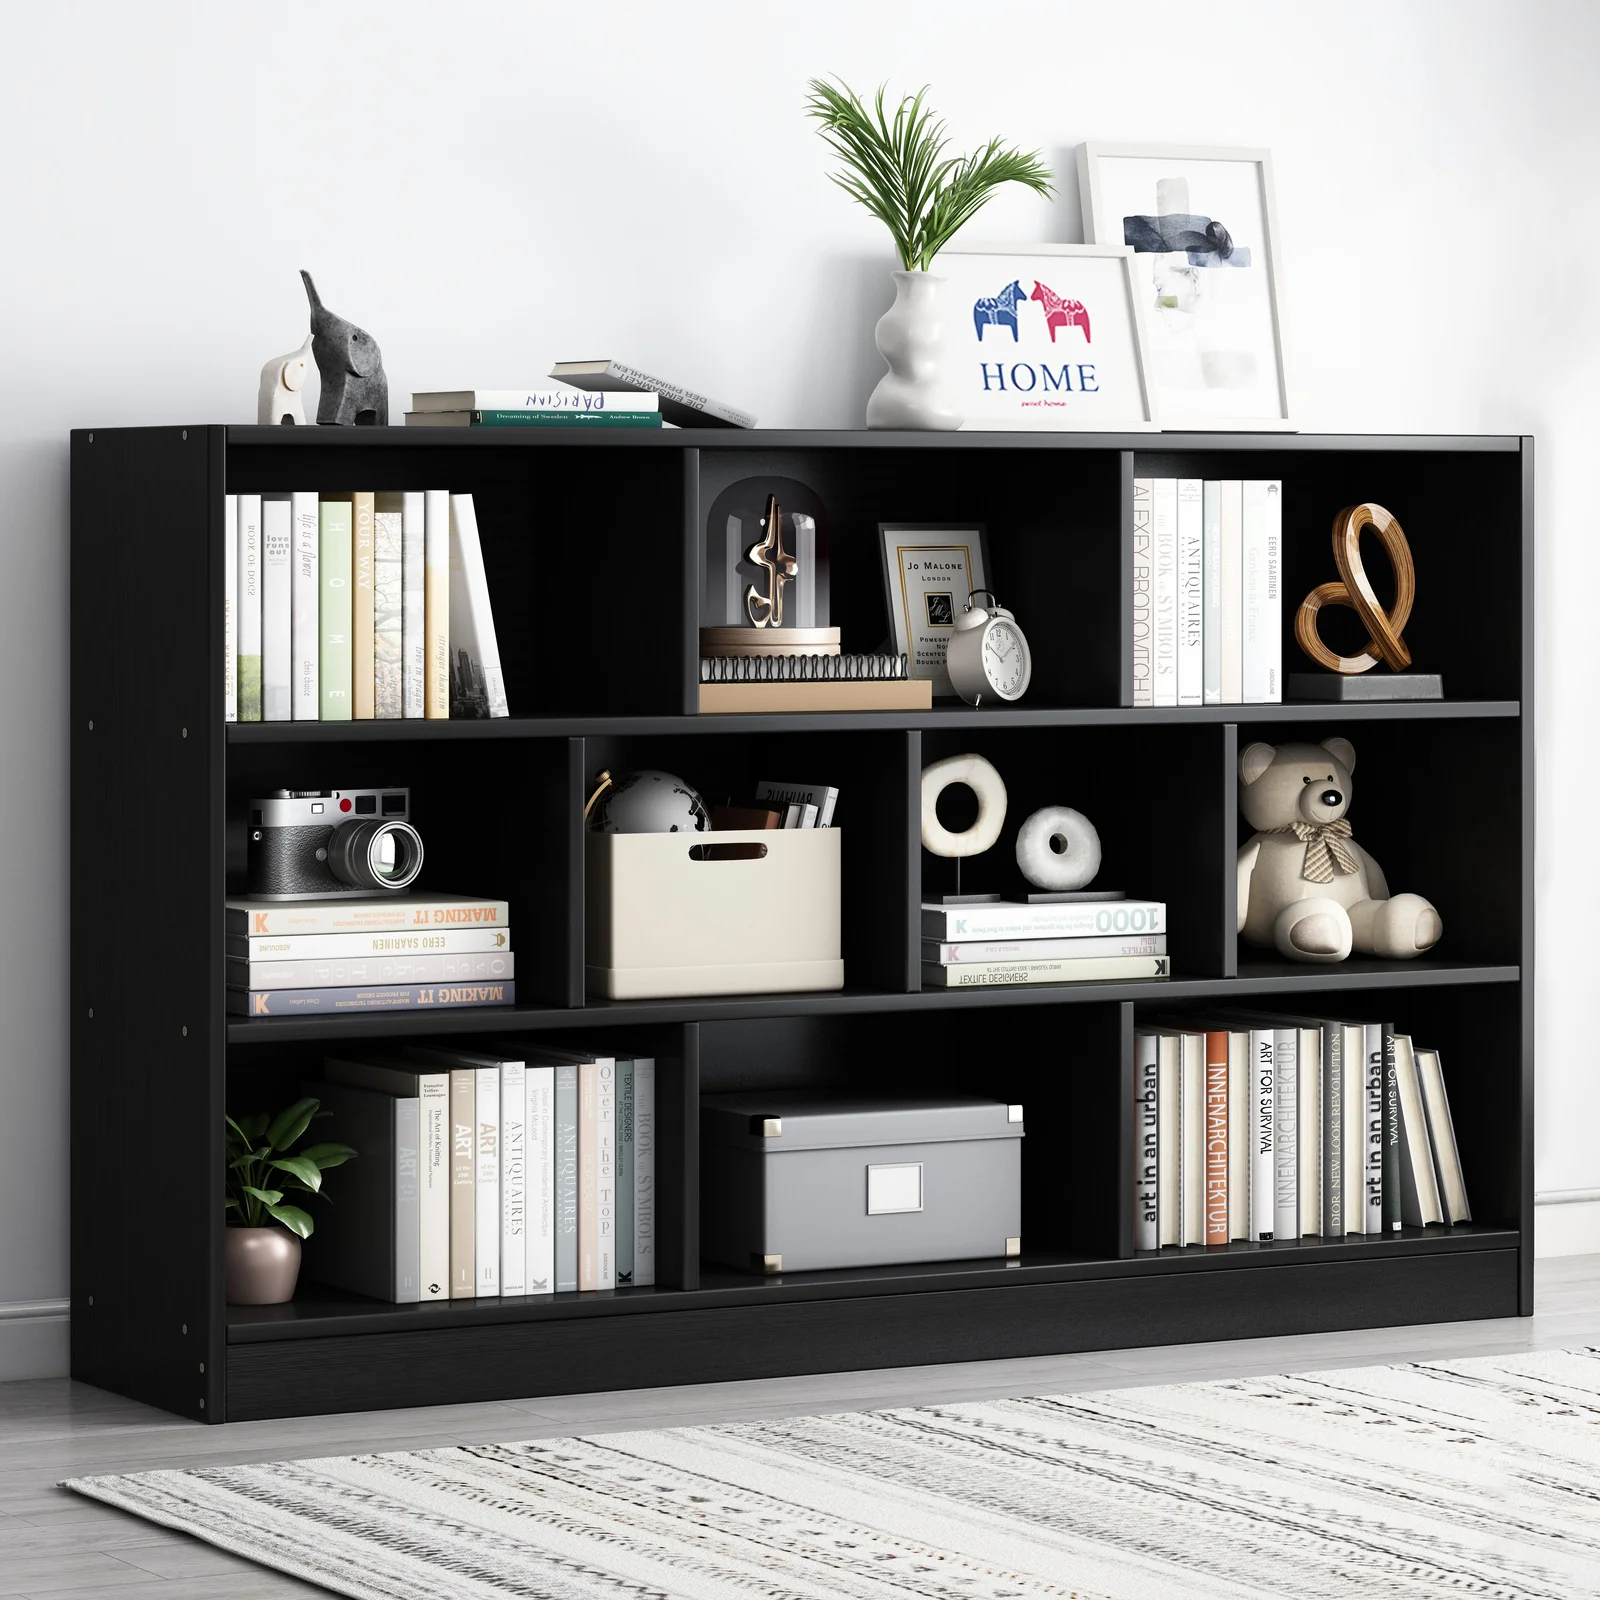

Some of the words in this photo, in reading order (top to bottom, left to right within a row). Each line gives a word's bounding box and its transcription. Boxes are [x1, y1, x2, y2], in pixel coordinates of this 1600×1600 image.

[613, 363, 684, 394] PRIMZAHLEN
[617, 373, 684, 404] EINSAMKEIT
[980, 363, 1099, 391] HOME
[526, 392, 605, 411] PARISIAN
[685, 390, 708, 404] DER
[685, 399, 704, 411] DIE
[718, 407, 750, 421] GIORDANO
[729, 415, 749, 426] PAOLO
[296, 514, 316, 528] life
[359, 503, 371, 548] YOUR
[1158, 533, 1173, 577] BOOK
[1269, 537, 1277, 556] EERO
[296, 549, 316, 577] flower
[359, 556, 371, 590] WAY
[1185, 537, 1200, 647] ANTIQUAIRES
[1269, 560, 1277, 599] SAARINEN
[329, 523, 345, 697] HOME
[996, 629, 1001, 638] 12
[1133, 567, 1149, 691] BRODOVITCH
[1158, 595, 1173, 675] SYMBOLS
[415, 647, 424, 663] love
[436, 635, 447, 669] stronger
[303, 661, 312, 675] chris
[416, 666, 423, 676] in
[303, 677, 312, 696] choice
[412, 679, 423, 708] prague
[438, 674, 447, 693] than
[439, 697, 447, 709] sin
[413, 910, 430, 924] IT
[434, 908, 497, 924] MAKING
[1096, 908, 1159, 932] 1000
[373, 938, 419, 950] SAARINEN
[422, 937, 445, 949] EERO
[1121, 946, 1157, 955] TEXTILES
[382, 964, 427, 979] the
[446, 960, 505, 977] Over
[367, 998, 410, 1006] MANUFACTURING
[417, 989, 434, 1004] IT
[438, 986, 503, 1004] MAKING
[1260, 1042, 1272, 1065] ART
[1386, 1035, 1396, 1062] ART
[624, 1073, 633, 1101] TEXTILE
[1260, 1070, 1272, 1095] FOR
[1331, 1033, 1341, 1116] REVOLUTION
[1366, 1052, 1382, 1111] urban
[1387, 1062, 1397, 1088] FOR
[530, 1089, 539, 1114] Virginia
[601, 1067, 612, 1119] Over
[637, 1094, 645, 1108] THE
[1136, 1063, 1156, 1127] urban
[434, 1109, 442, 1121] The
[434, 1122, 442, 1133] Art
[531, 1115, 539, 1140] McLeod
[624, 1102, 633, 1143] DESIGNERS
[1260, 1098, 1272, 1155] SURVIVAL
[1277, 1041, 1296, 1209] INNENARCHITEKTUR
[1388, 1091, 1399, 1146] SURVIVAL
[455, 1123, 472, 1160] ART
[480, 1122, 497, 1158] ART
[539, 1115, 549, 1160] Contemporary
[638, 1112, 651, 1158] BOOK
[1331, 1120, 1341, 1155] LOOK
[1370, 1119, 1382, 1144] an
[433, 1141, 442, 1167] Knitting
[602, 1137, 611, 1175] the
[1142, 1133, 1156, 1159] an
[1208, 1063, 1227, 1234] INNENARCHITEKTUR
[400, 1147, 416, 1179] ART
[1331, 1159, 1341, 1188] NEW
[1365, 1150, 1382, 1170] in
[508, 1121, 523, 1236] ANTIQUAIRES
[562, 1123, 576, 1233] ANTIQUAIRES
[1137, 1165, 1156, 1186] in
[1366, 1177, 1382, 1207] art
[638, 1175, 652, 1255] SYMBOLS
[1140, 1192, 1156, 1222] art
[1331, 1194, 1341, 1227] DIOR.
